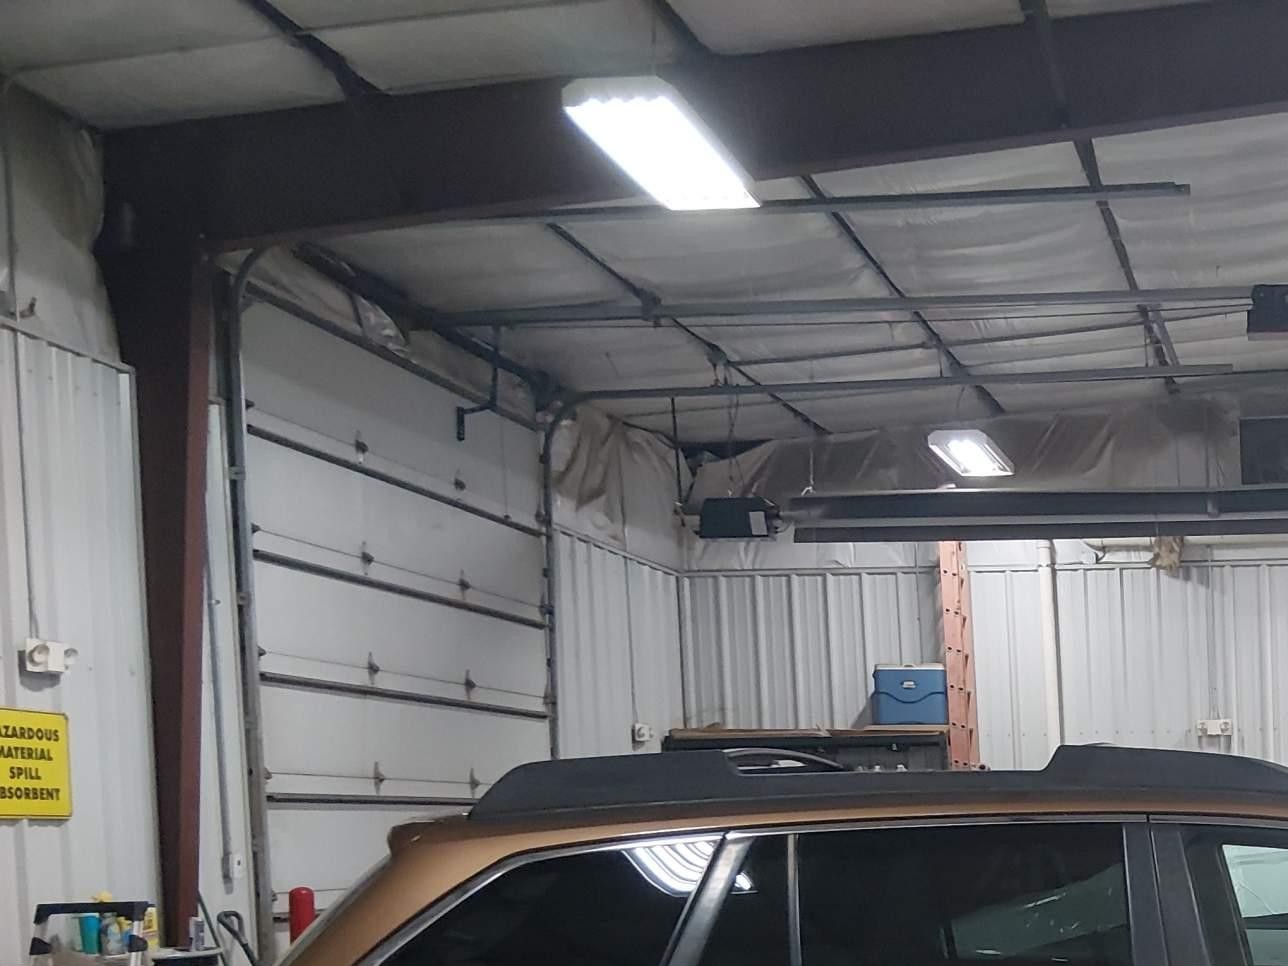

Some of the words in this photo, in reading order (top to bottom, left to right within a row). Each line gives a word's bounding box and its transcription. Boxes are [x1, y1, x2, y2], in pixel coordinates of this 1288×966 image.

[0, 725, 59, 742] ZARDOUS
[9, 766, 42, 780] SPILL
[0, 786, 60, 801] BSORBENT
